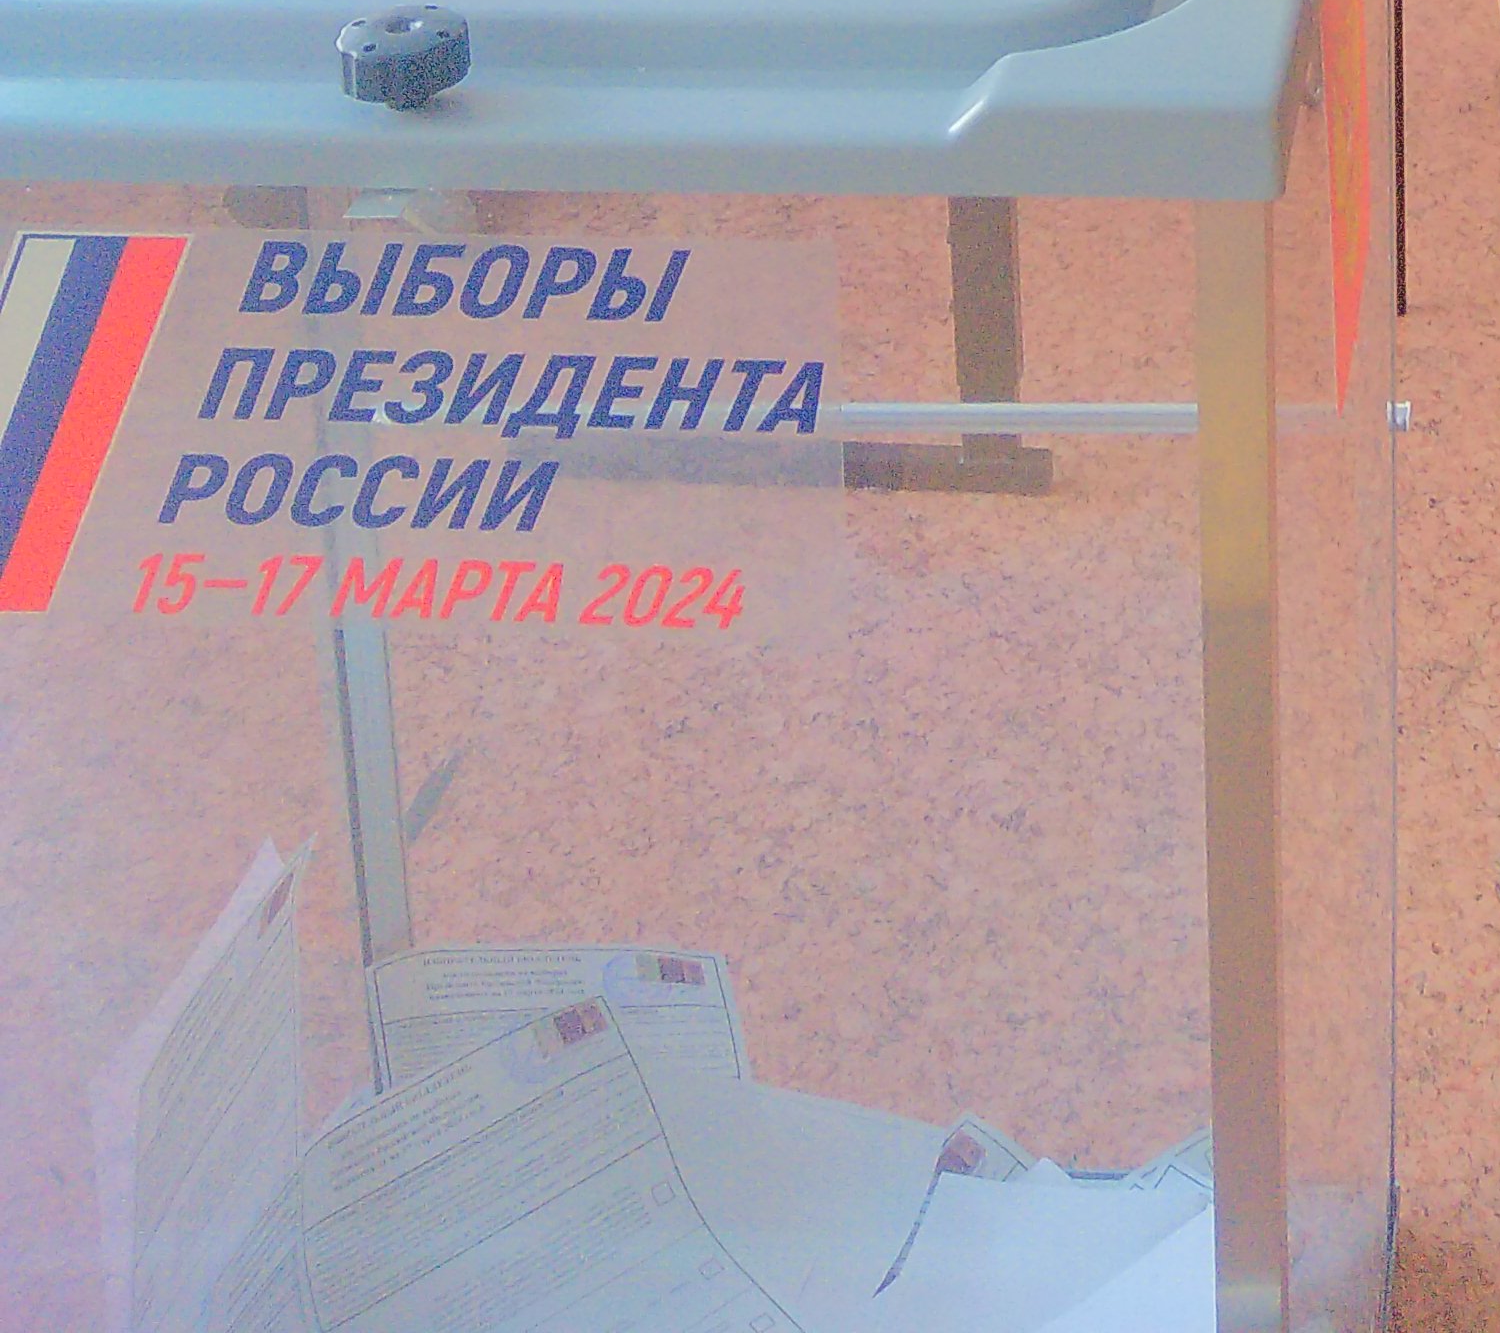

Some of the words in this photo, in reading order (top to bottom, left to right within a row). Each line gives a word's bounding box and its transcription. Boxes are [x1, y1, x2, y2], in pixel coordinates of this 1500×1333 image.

[239, 239, 690, 322] ВЫБОРЫ
[199, 346, 825, 439] ПРЕЗИДЕНТА
[157, 452, 561, 532] РОССИИ
[331, 557, 564, 623] МАРТА
[578, 563, 745, 630] 2024
